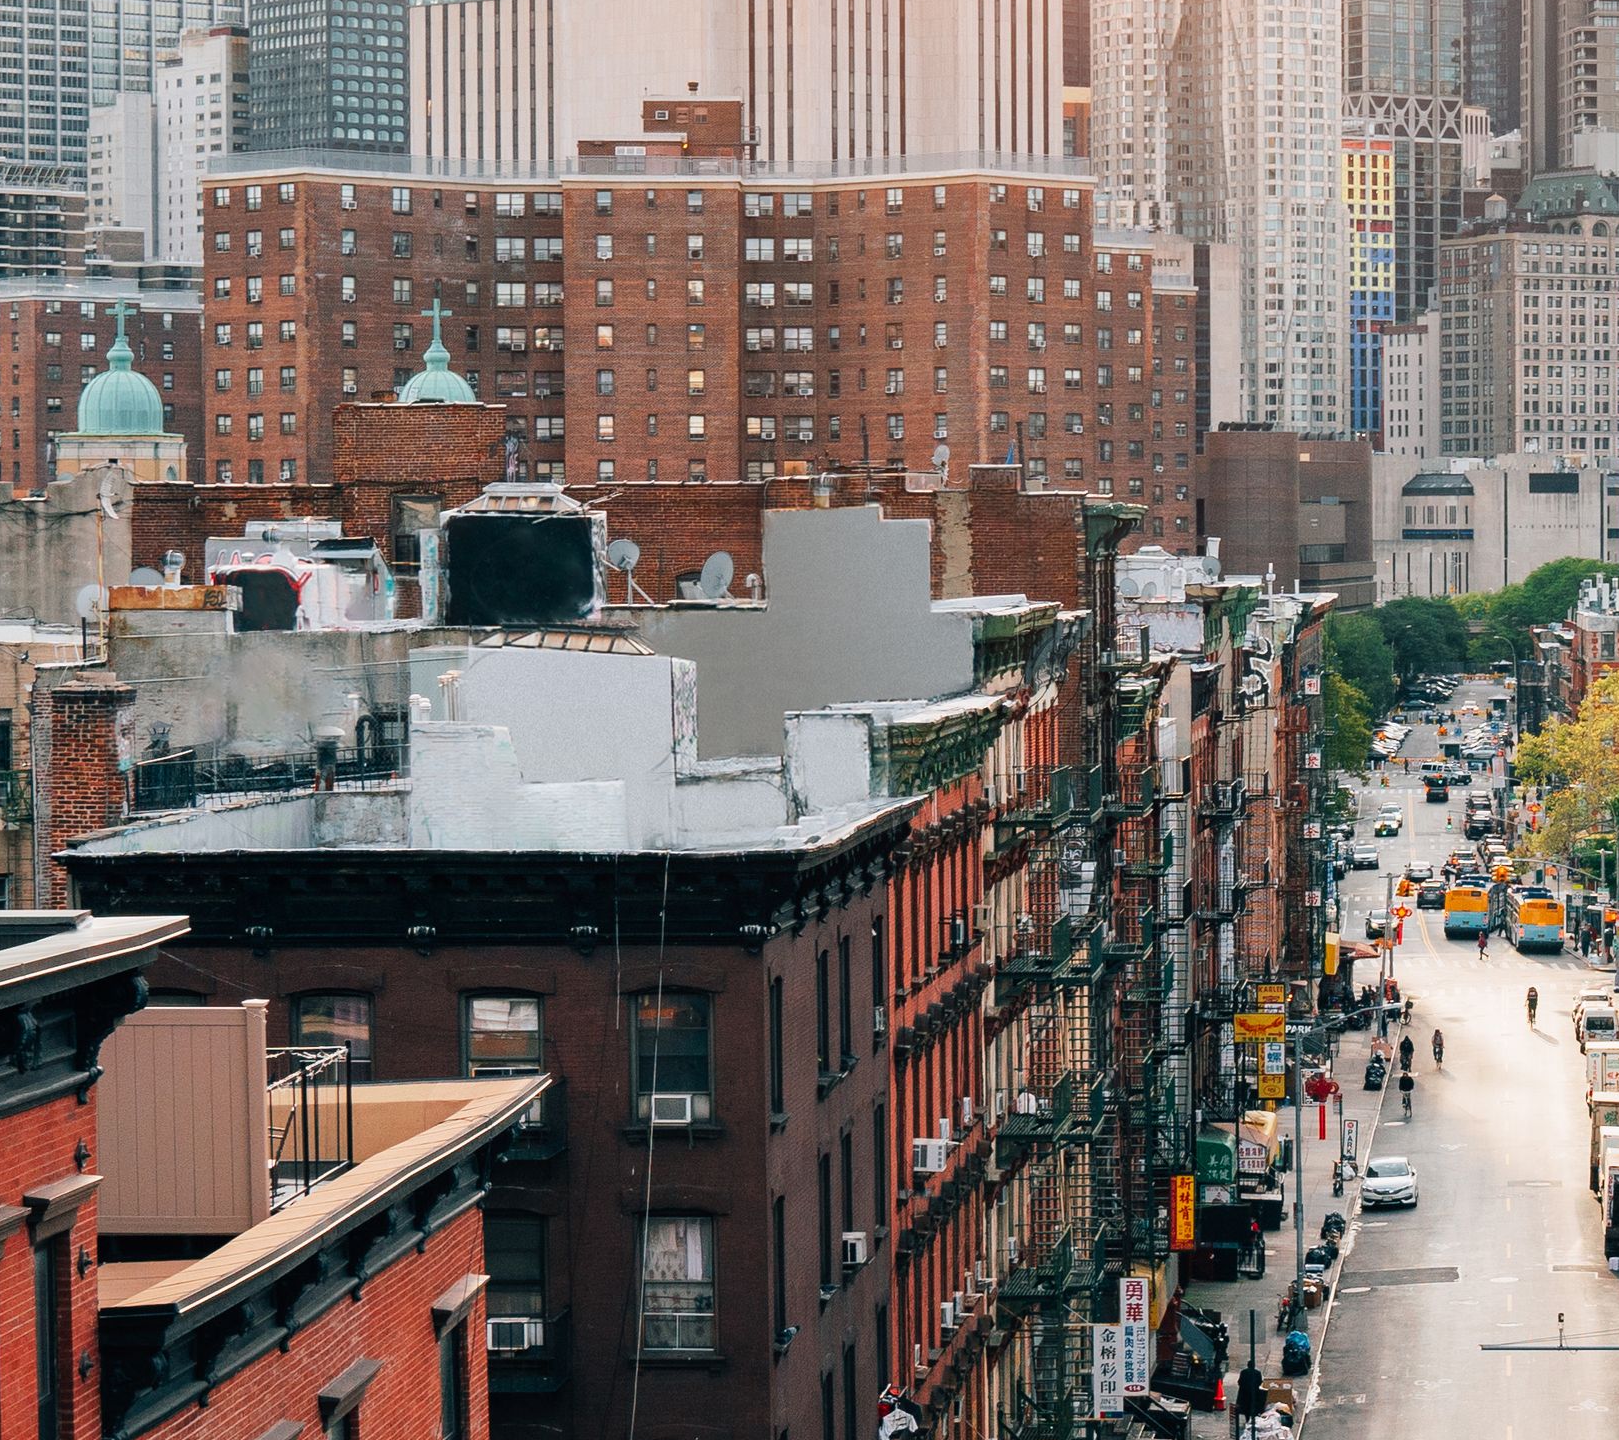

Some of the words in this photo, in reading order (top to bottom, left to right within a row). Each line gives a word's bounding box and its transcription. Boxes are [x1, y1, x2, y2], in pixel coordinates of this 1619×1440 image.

[1285, 1025, 1312, 1034] PARK
[1346, 1129, 1354, 1155] PARK
[1125, 1280, 1144, 1322] 勇華
